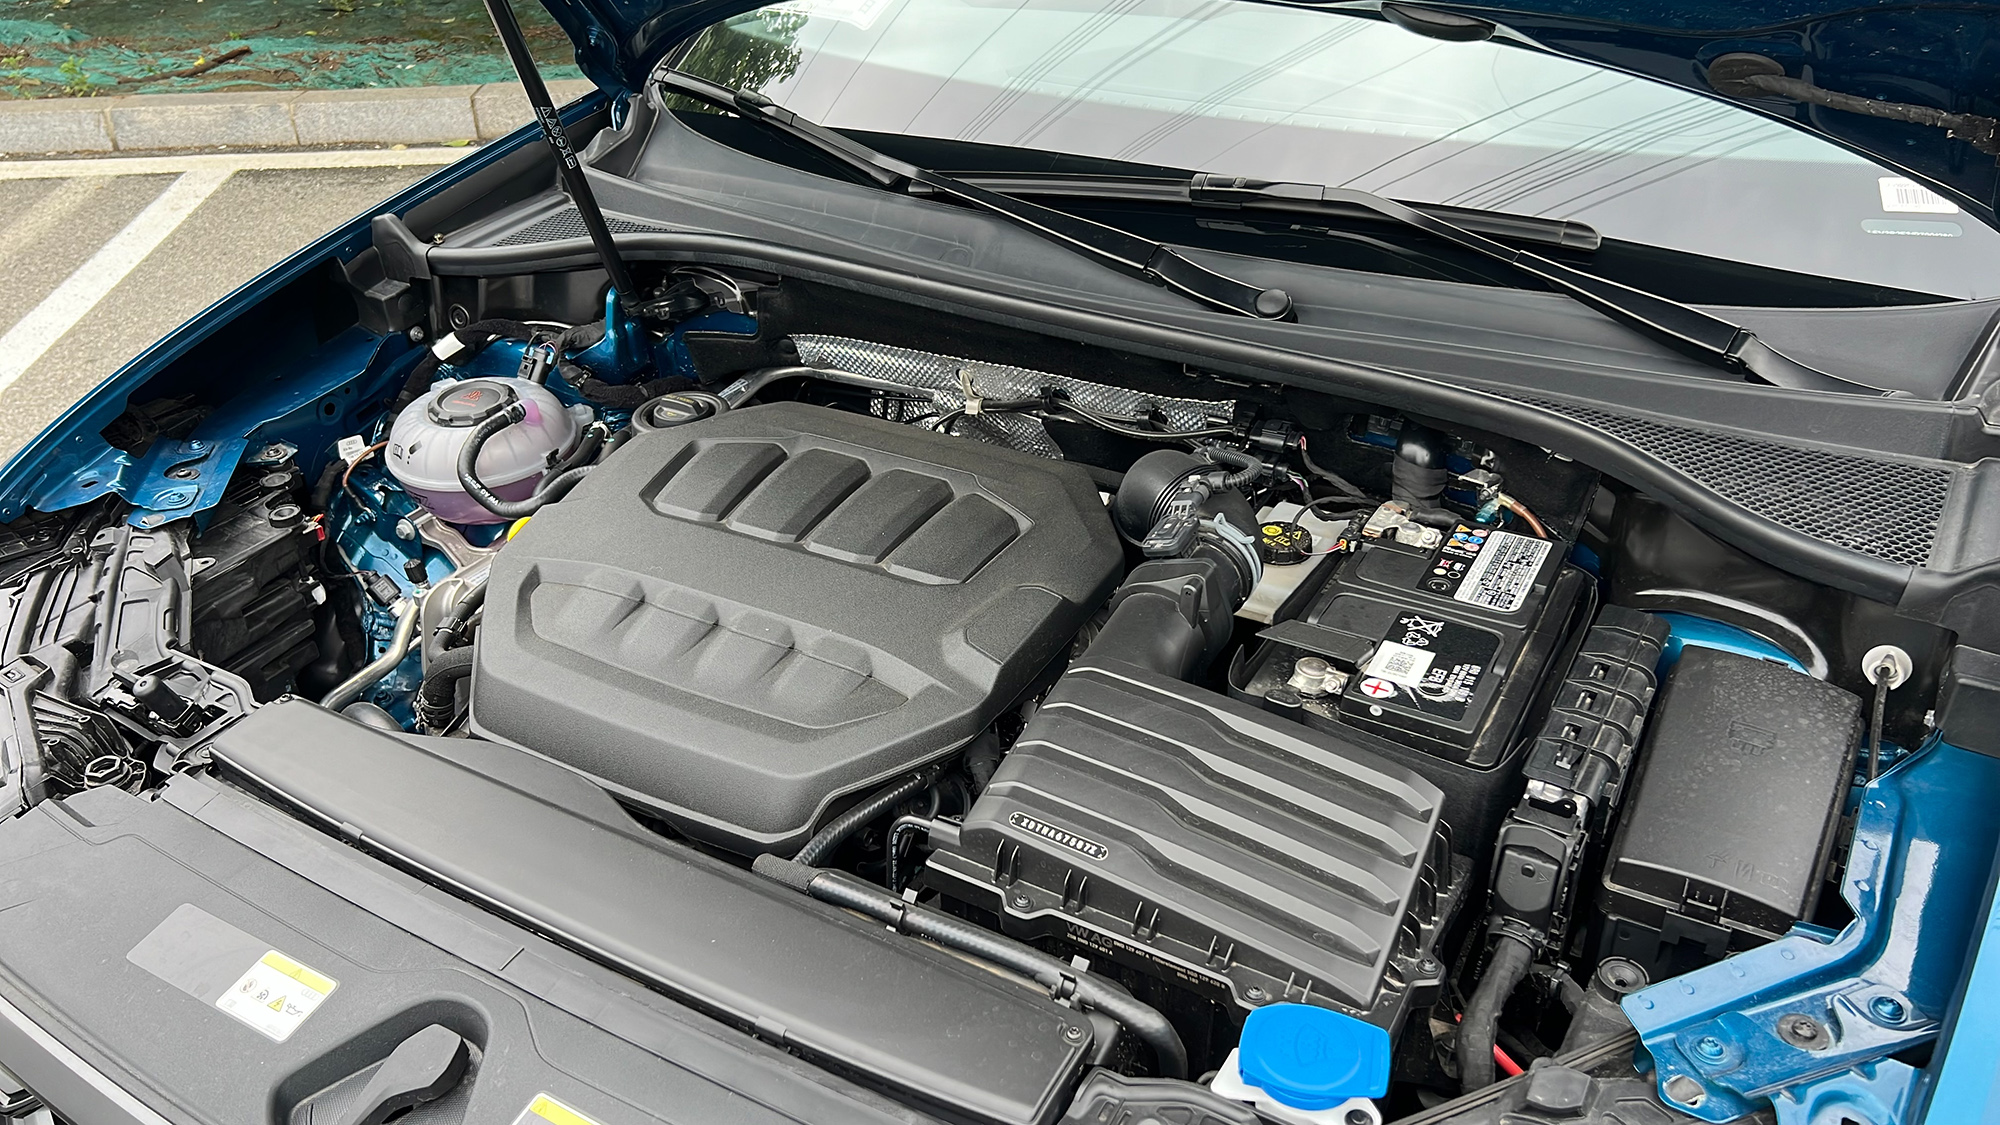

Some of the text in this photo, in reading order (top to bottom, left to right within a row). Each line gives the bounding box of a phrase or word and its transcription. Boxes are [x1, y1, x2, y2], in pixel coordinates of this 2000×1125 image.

[1428, 667, 1448, 683] EFB
[1066, 921, 1113, 948] VW AG
[1089, 941, 1099, 950] 129
[1125, 945, 1135, 953] 129
[1198, 974, 1209, 982] 129
